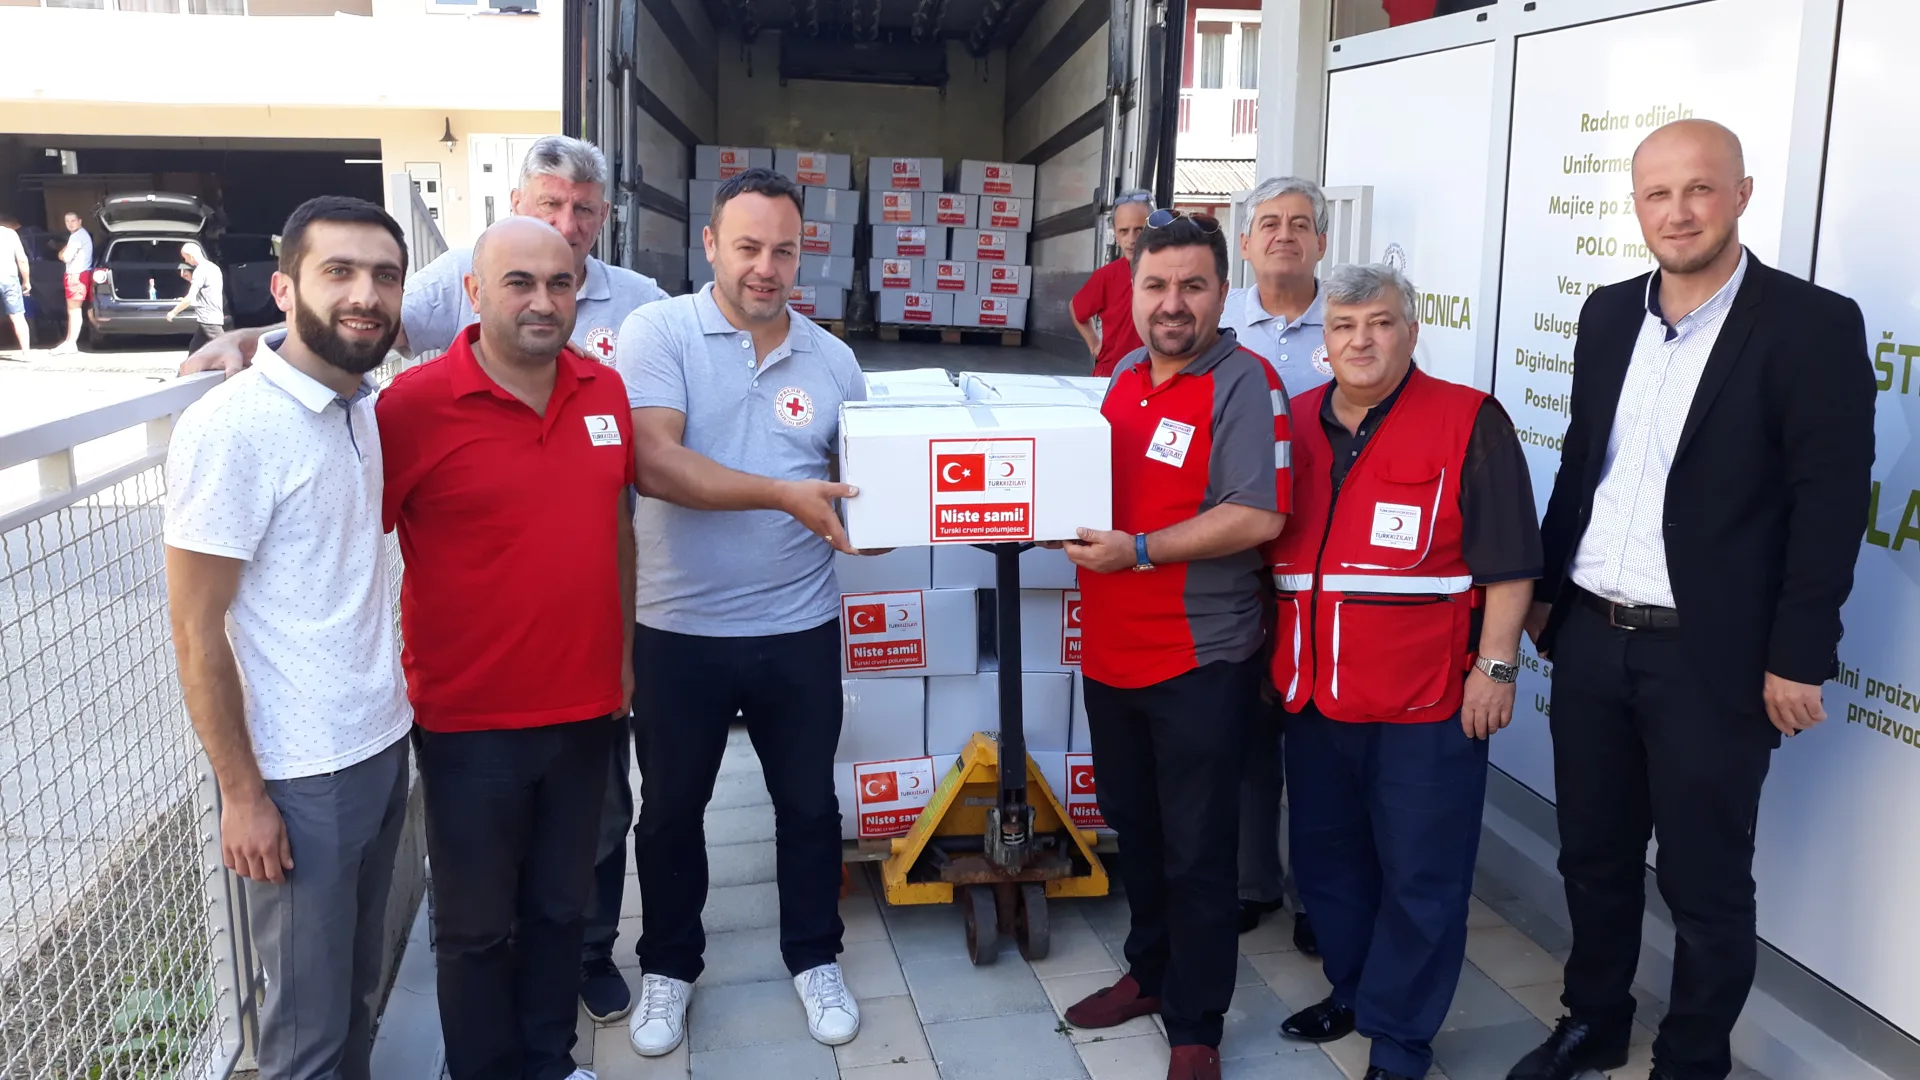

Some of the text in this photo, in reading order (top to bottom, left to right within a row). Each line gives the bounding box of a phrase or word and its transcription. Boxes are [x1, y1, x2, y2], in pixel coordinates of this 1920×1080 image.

[1580, 102, 1694, 132] Radna odijela
[1563, 153, 1632, 174] Uniforme
[1548, 195, 1595, 219] Majice
[1598, 201, 1618, 220] po
[1576, 236, 1618, 256] POLO
[1557, 275, 1582, 296] Vez
[1534, 312, 1579, 339] Usluge
[1874, 331, 1920, 396] ŠT
[941, 507, 1024, 523] Niste sami!
[985, 525, 1025, 534] polumjesec
[854, 643, 918, 658] Niste sami!
[866, 815, 896, 825] Niste
